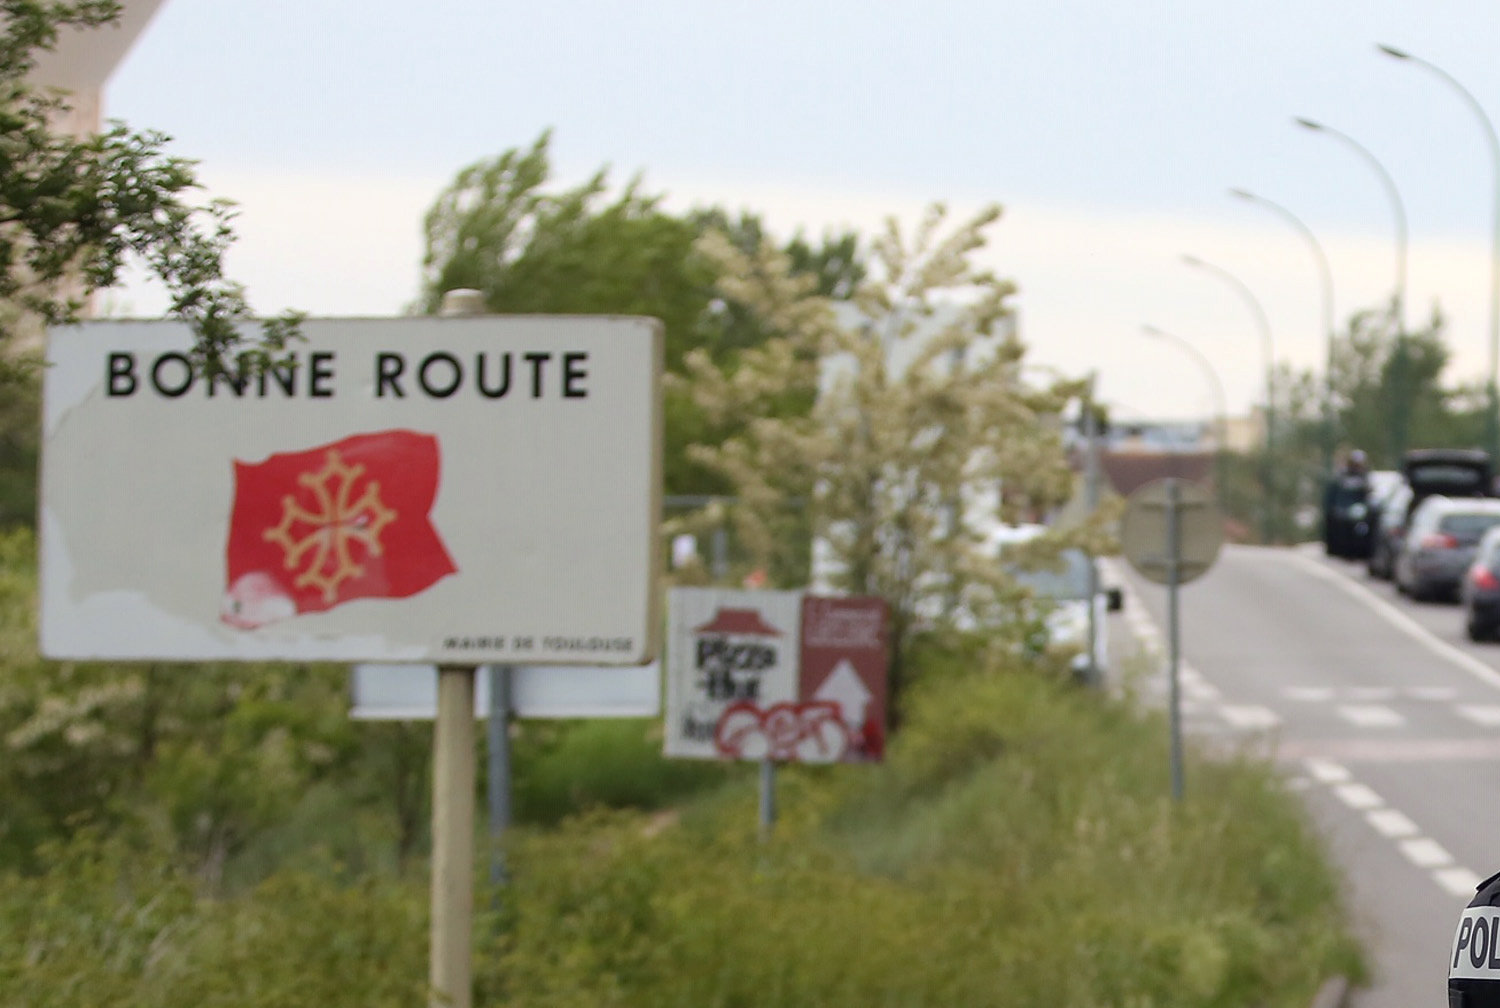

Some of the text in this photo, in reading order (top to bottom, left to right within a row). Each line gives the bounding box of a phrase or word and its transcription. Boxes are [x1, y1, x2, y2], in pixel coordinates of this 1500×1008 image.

[106, 351, 589, 399] BONNE ROUTE
[442, 636, 633, 651] MAIRIE DE TOULOUSE
